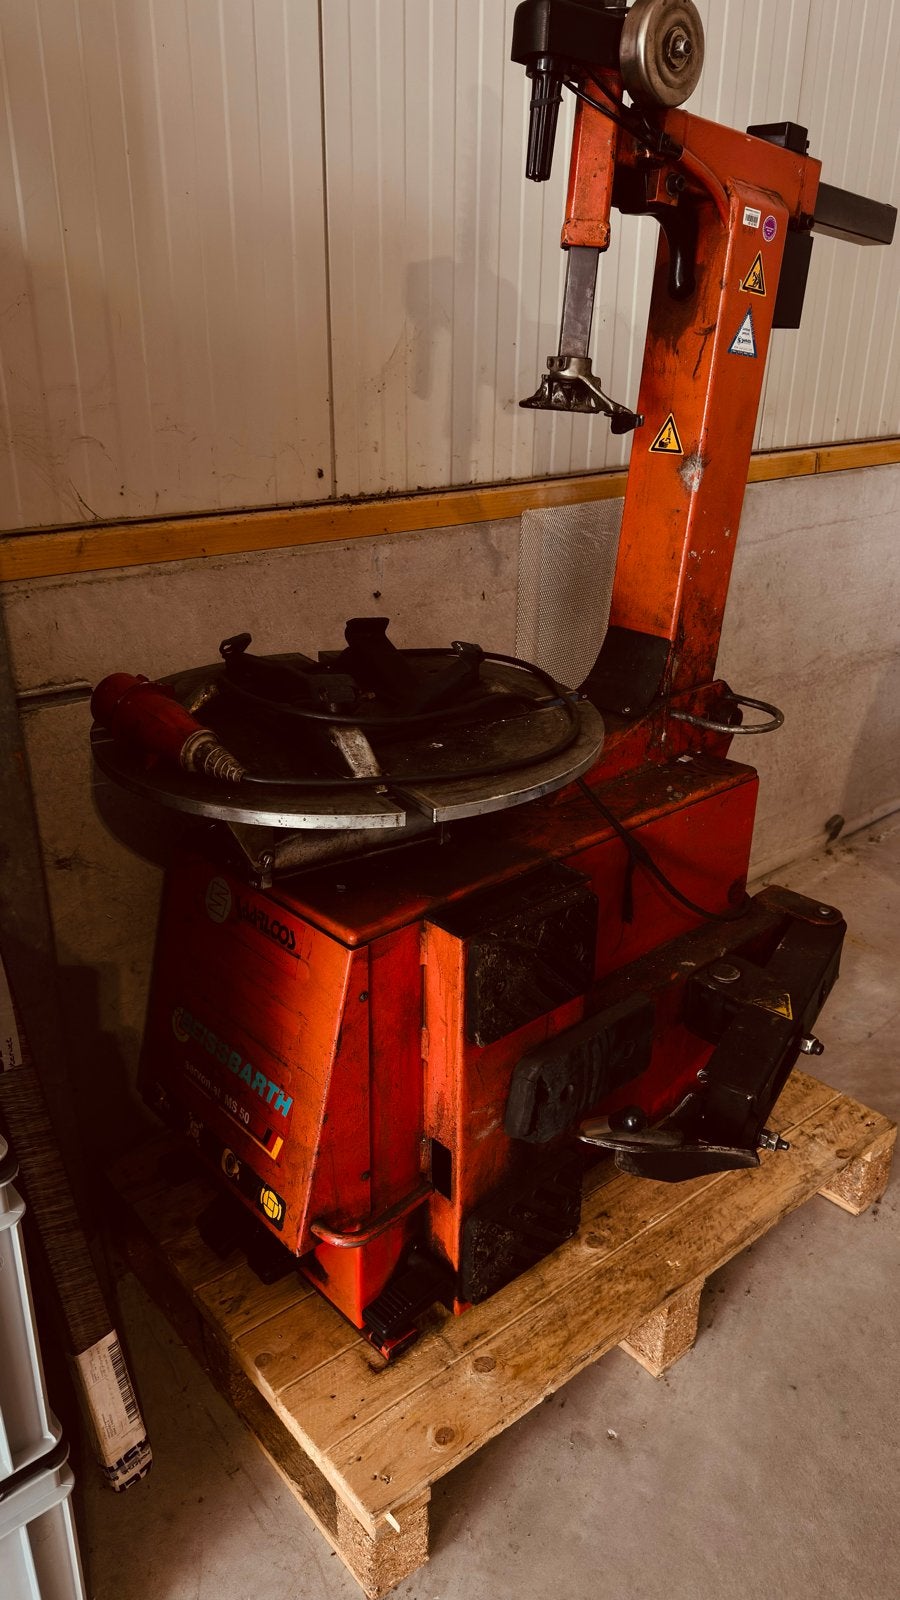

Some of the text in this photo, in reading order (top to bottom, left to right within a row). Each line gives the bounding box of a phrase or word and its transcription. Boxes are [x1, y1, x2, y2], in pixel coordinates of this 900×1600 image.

[182, 1012, 294, 1118] BEISSBARTH
[224, 1094, 238, 1114] MS
[238, 1106, 251, 1125] 50
